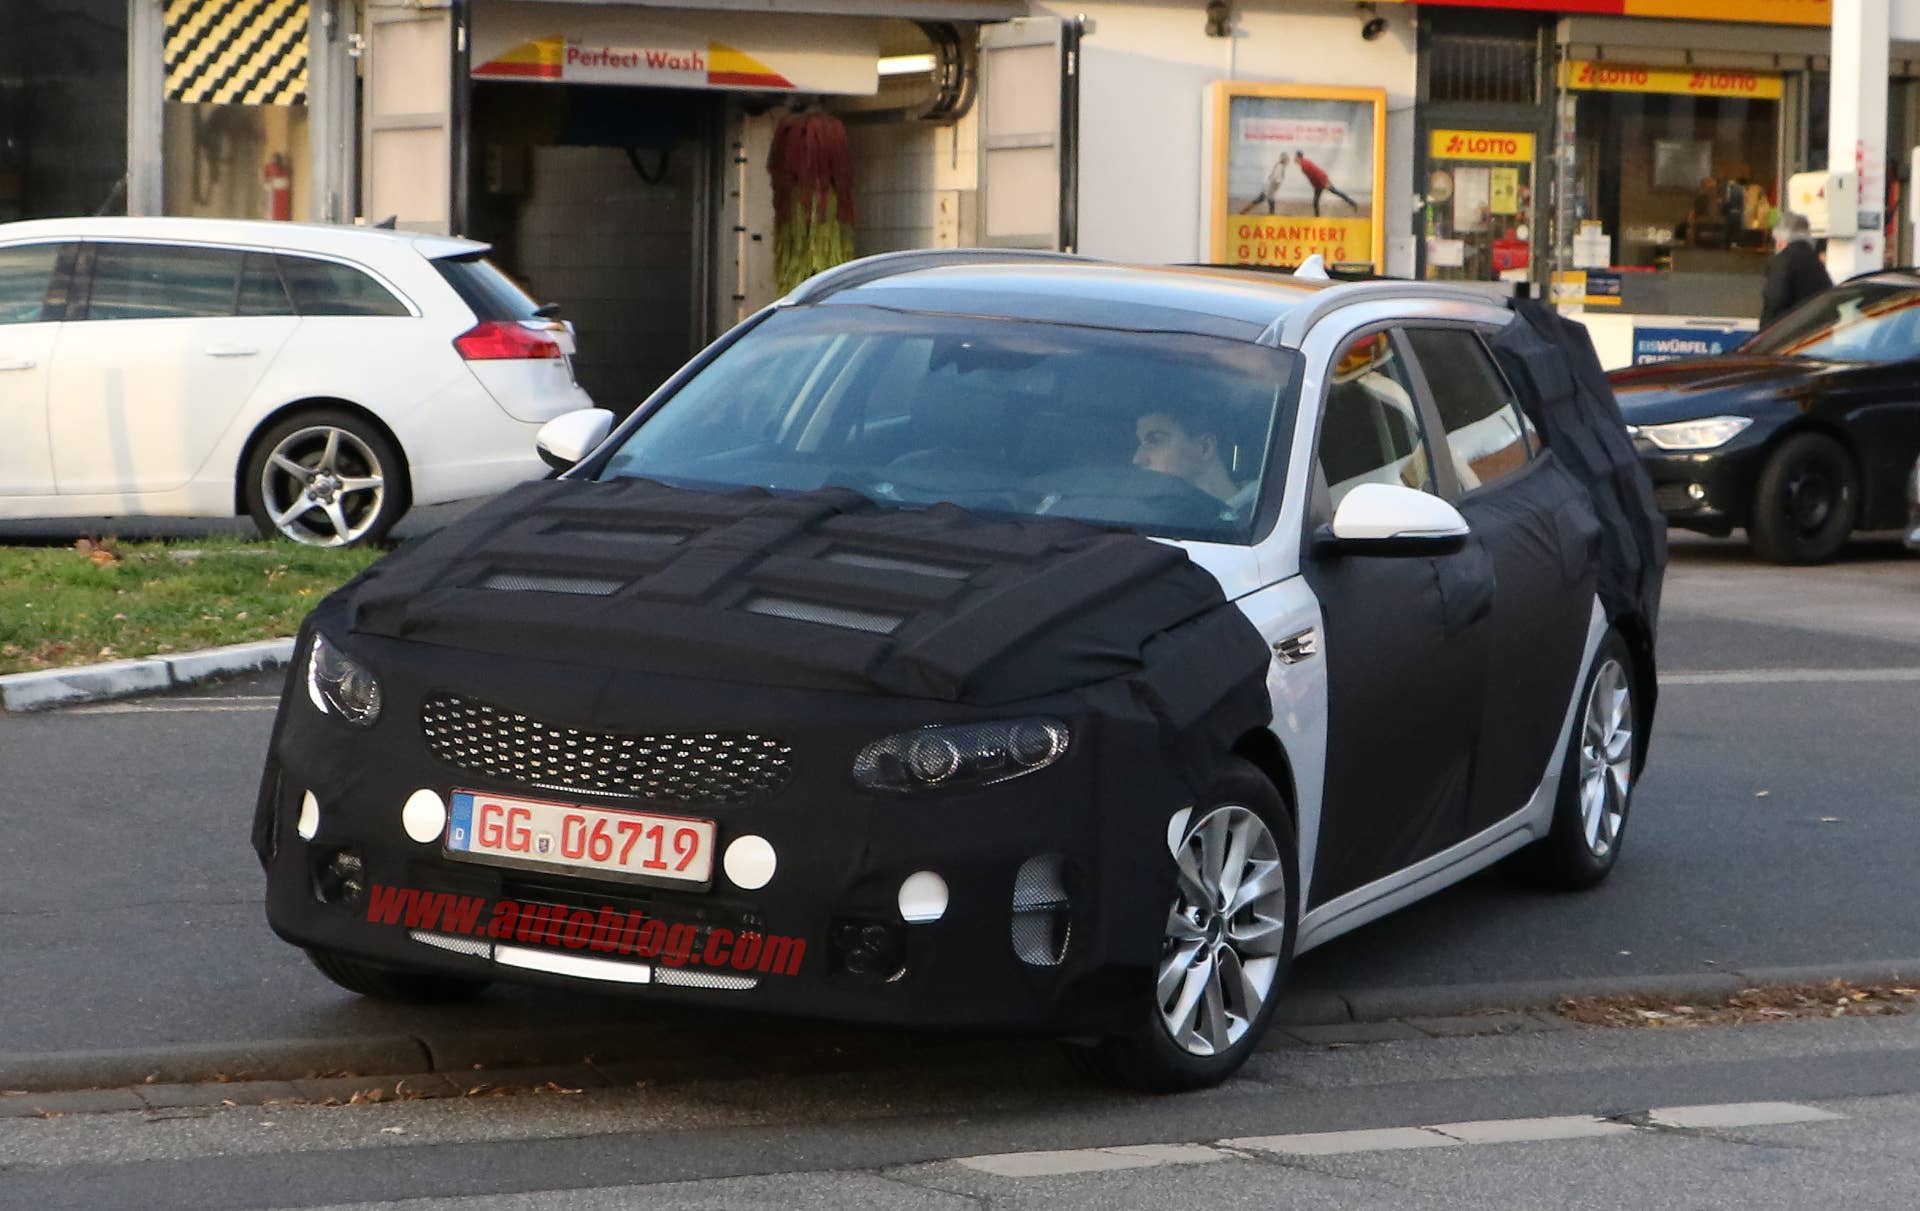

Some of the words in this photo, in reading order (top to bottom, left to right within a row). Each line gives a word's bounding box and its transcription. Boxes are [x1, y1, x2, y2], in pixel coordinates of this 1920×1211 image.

[567, 47, 639, 68] Perfect
[646, 50, 704, 71] Wash
[1600, 68, 1648, 85] LOTTO
[1711, 73, 1757, 91] LOTTO
[1468, 138, 1517, 154] LOTTO
[1238, 224, 1347, 242] GARANTIERT
[1639, 338, 1707, 353] EISWÜRFEL
[455, 827, 465, 840] D
[478, 803, 532, 852] GG
[560, 814, 699, 872] 06719
